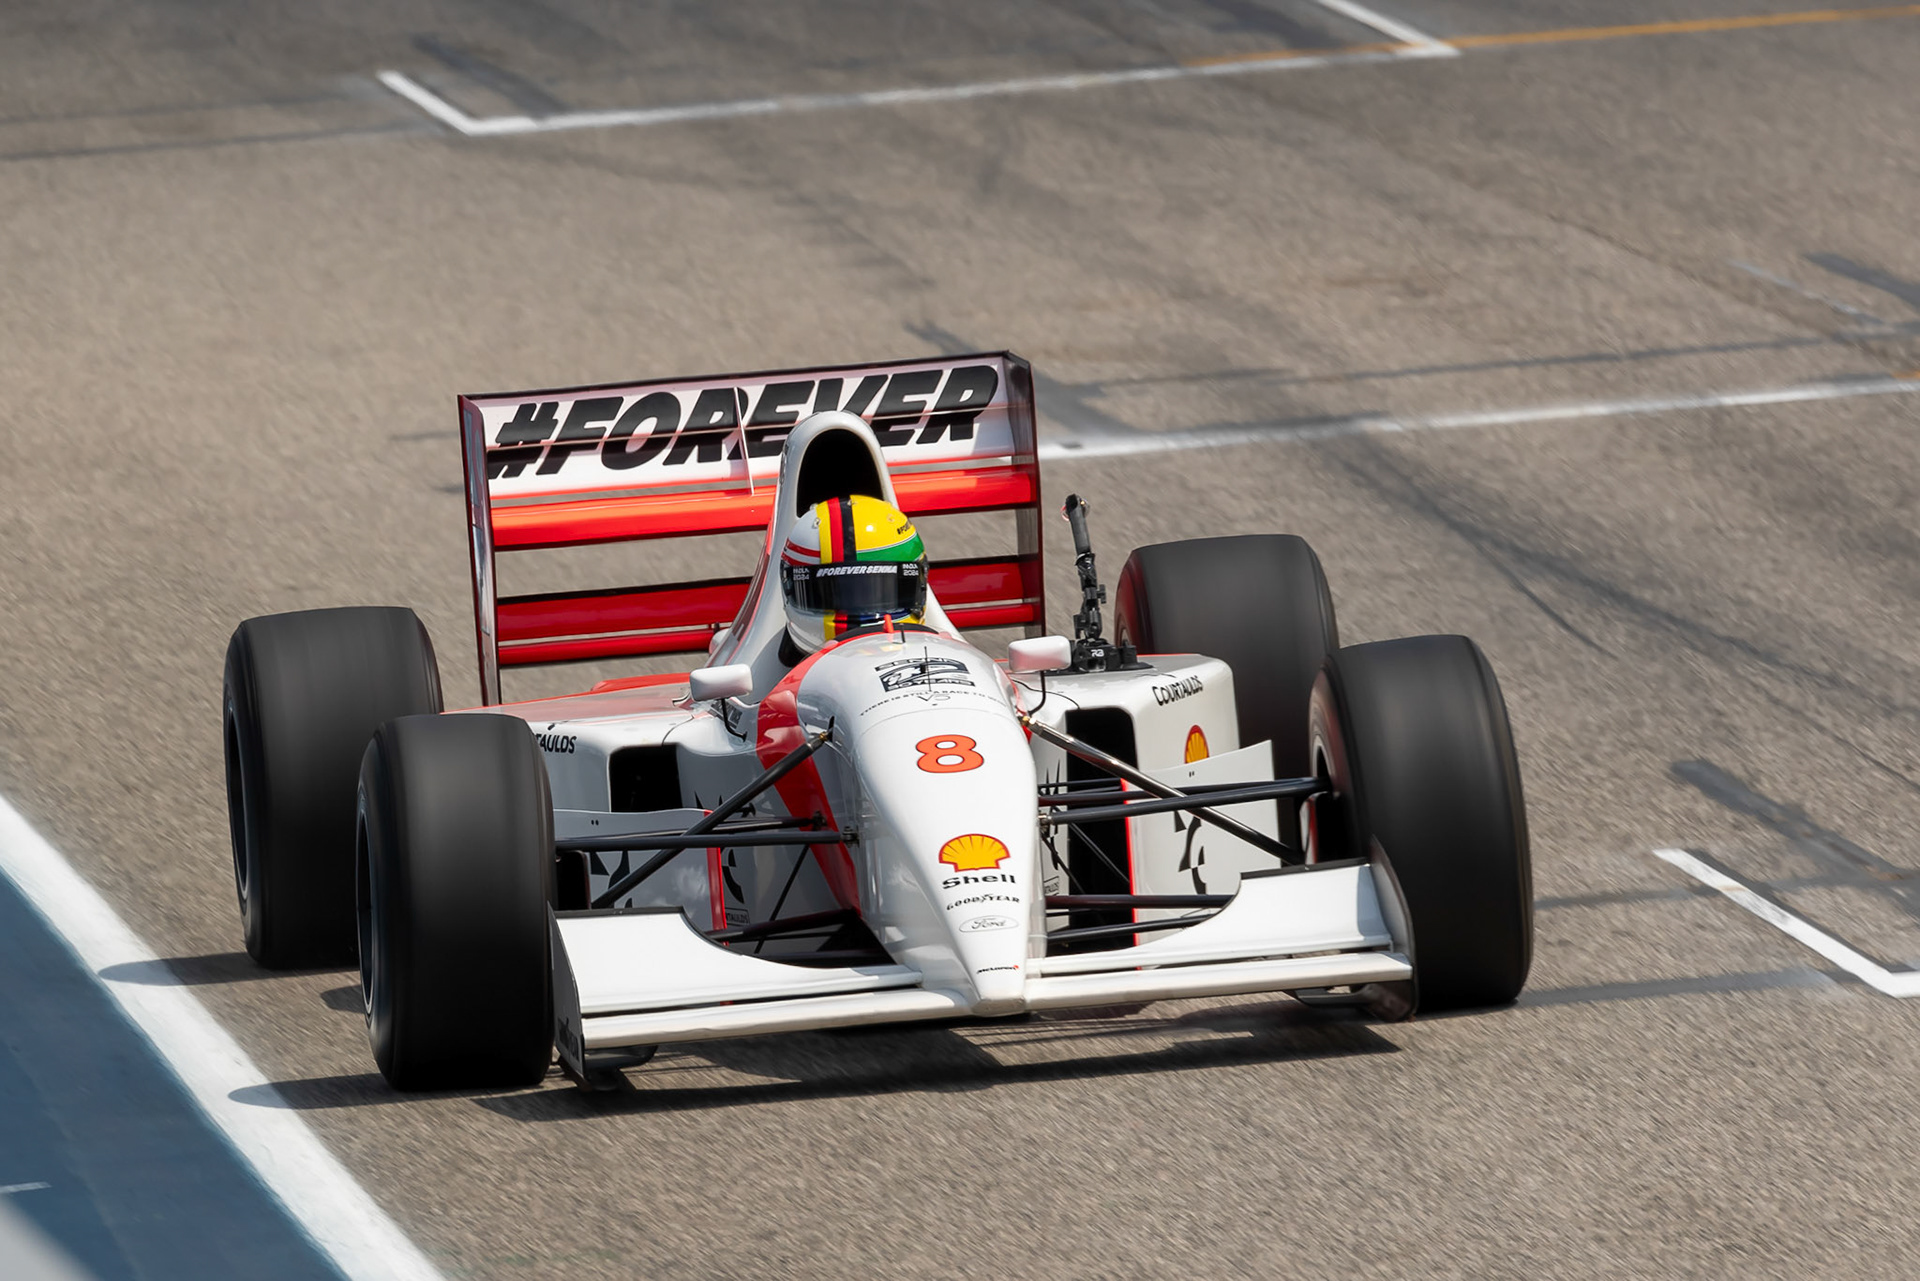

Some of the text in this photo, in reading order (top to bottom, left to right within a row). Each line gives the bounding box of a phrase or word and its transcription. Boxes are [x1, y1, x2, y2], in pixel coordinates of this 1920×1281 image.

[486, 365, 999, 480] #FOREVER
[915, 733, 985, 774] 8
[942, 873, 1017, 890] Shell
[946, 893, 1020, 911] GOODYEAR
[971, 917, 1007, 930] Ford
